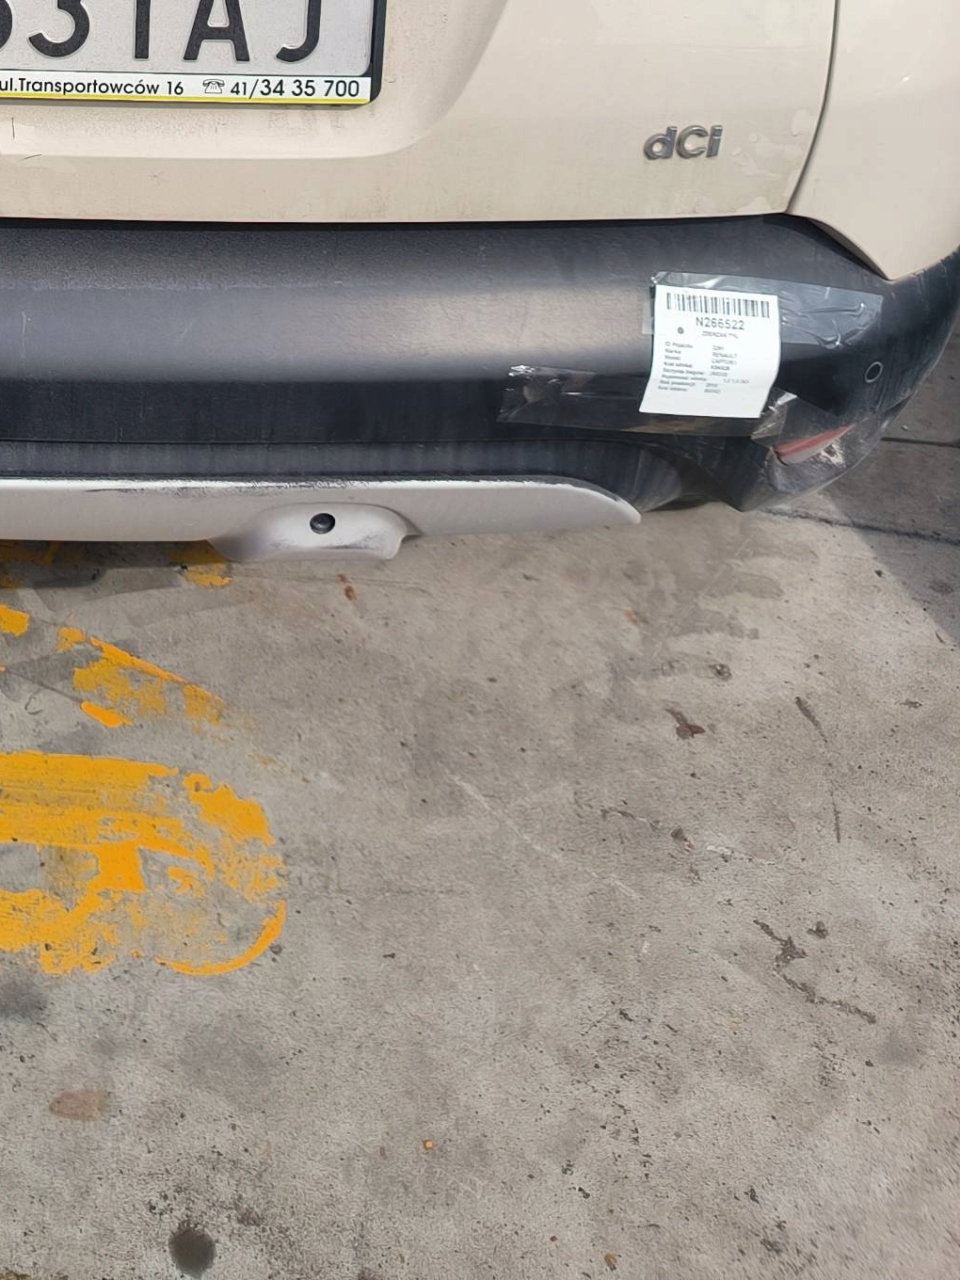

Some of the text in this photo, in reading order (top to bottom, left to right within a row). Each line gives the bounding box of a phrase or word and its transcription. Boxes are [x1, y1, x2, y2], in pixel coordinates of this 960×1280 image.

[0, 77, 159, 97] ul.Transportowców
[167, 82, 183, 95] 16
[230, 78, 285, 99] 41/34
[292, 79, 316, 97] 35
[324, 81, 360, 97] 700
[696, 317, 745, 330] N266522
